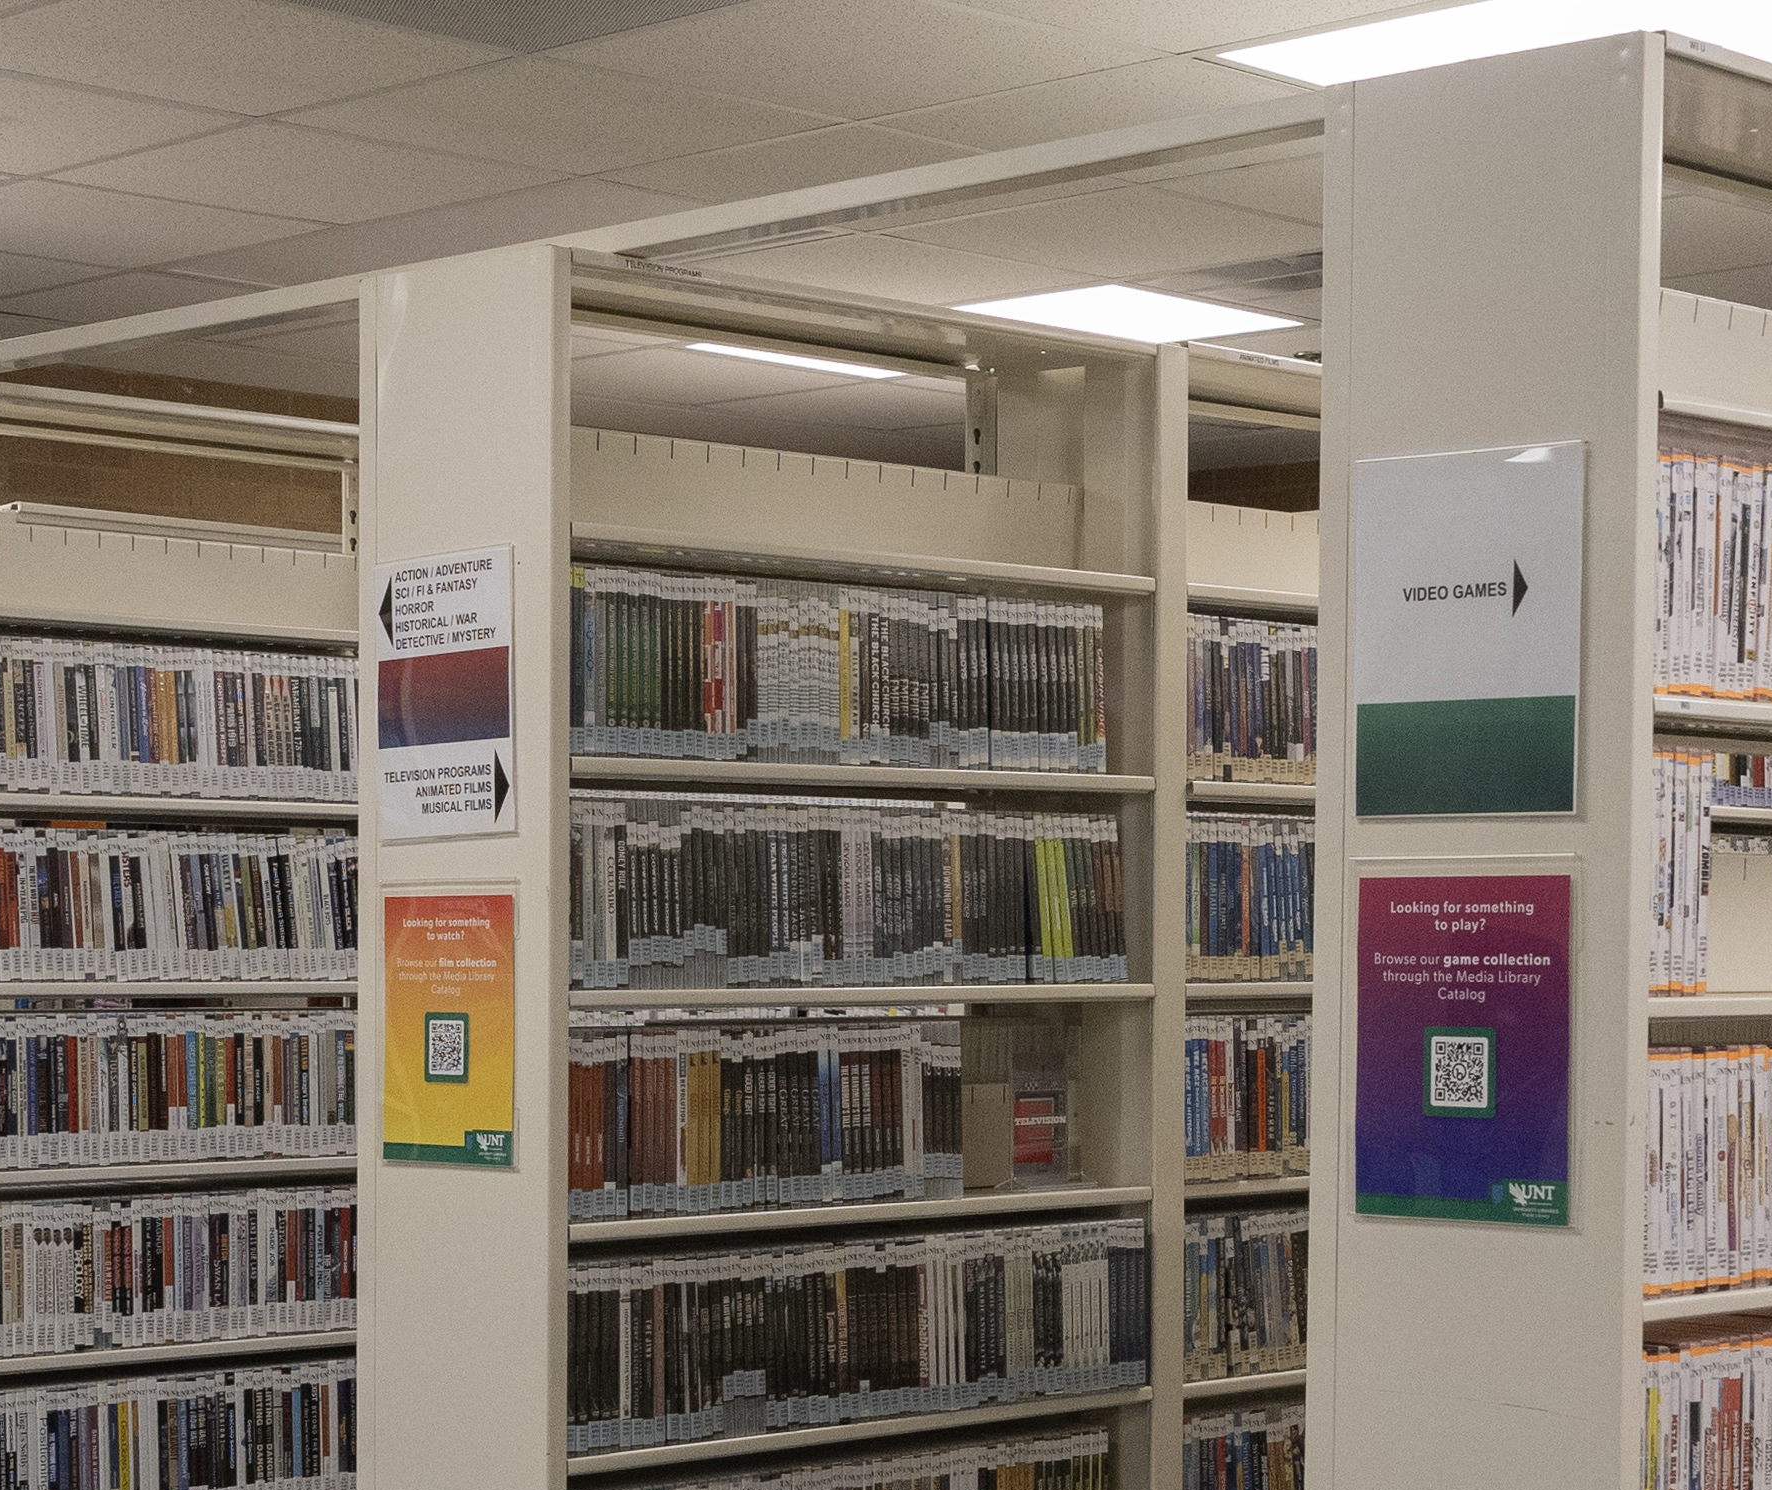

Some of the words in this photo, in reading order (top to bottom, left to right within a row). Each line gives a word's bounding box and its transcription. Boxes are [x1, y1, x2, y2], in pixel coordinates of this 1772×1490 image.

[394, 568, 428, 583] ACTION
[435, 558, 493, 577] ADVENTURE
[395, 587, 410, 600] SCI
[416, 585, 425, 597] FI
[427, 583, 433, 595] &
[436, 577, 478, 594] FANTASY
[1403, 585, 1448, 602] VIDEO
[1452, 581, 1507, 599] GAMES
[395, 600, 435, 617] HORROR
[395, 617, 449, 633] HISTORICAL
[455, 612, 478, 626] WAR
[870, 616, 879, 638] THE
[880, 619, 889, 640] THE
[395, 633, 445, 650] DETECTIVE
[452, 626, 497, 643] MYSTERY
[871, 641, 880, 679] BLACK
[881, 642, 890, 682] BLACK
[871, 681, 880, 728] CHURCH
[882, 684, 891, 731] CHURCH
[384, 769, 435, 783] TELEVISION
[437, 763, 492, 780] PROGRAMS
[415, 783, 462, 798] ANIMATED
[464, 781, 492, 795] FILMS
[421, 800, 463, 815] MUSICAL
[464, 798, 493, 812] FILMS
[617, 840, 625, 866] COMEY
[606, 856, 615, 916] COLUMBO
[618, 868, 626, 890] RULE
[771, 871, 779, 903] WHITE
[1390, 900, 1440, 916] Looking
[1442, 900, 1460, 913] for
[1464, 900, 1534, 915] something
[403, 918, 434, 929] Looking
[435, 917, 447, 928] for
[448, 917, 491, 930] something
[772, 905, 780, 949] PEOPLE
[1434, 919, 1448, 931] to
[1451, 918, 1487, 933] play?
[426, 932, 435, 940] to
[436, 930, 465, 941] watch?
[397, 958, 424, 968] Browse
[425, 960, 437, 968] our
[438, 957, 455, 968] film
[455, 957, 497, 968] collection
[1374, 952, 1417, 965] Browse
[1420, 955, 1440, 965] our
[1443, 955, 1480, 967] game
[1482, 953, 1551, 966] collection
[399, 971, 428, 983] through
[429, 971, 442, 980] the
[443, 971, 467, 980] Media
[468, 971, 495, 983] Library
[1383, 969, 1430, 985] through
[1433, 970, 1453, 982] the
[1456, 970, 1495, 983] Media
[1498, 970, 1541, 986] Library
[431, 984, 461, 997] Catalog
[1437, 987, 1486, 1004] Catalog
[1014, 1115, 1067, 1127] TELEVISION
